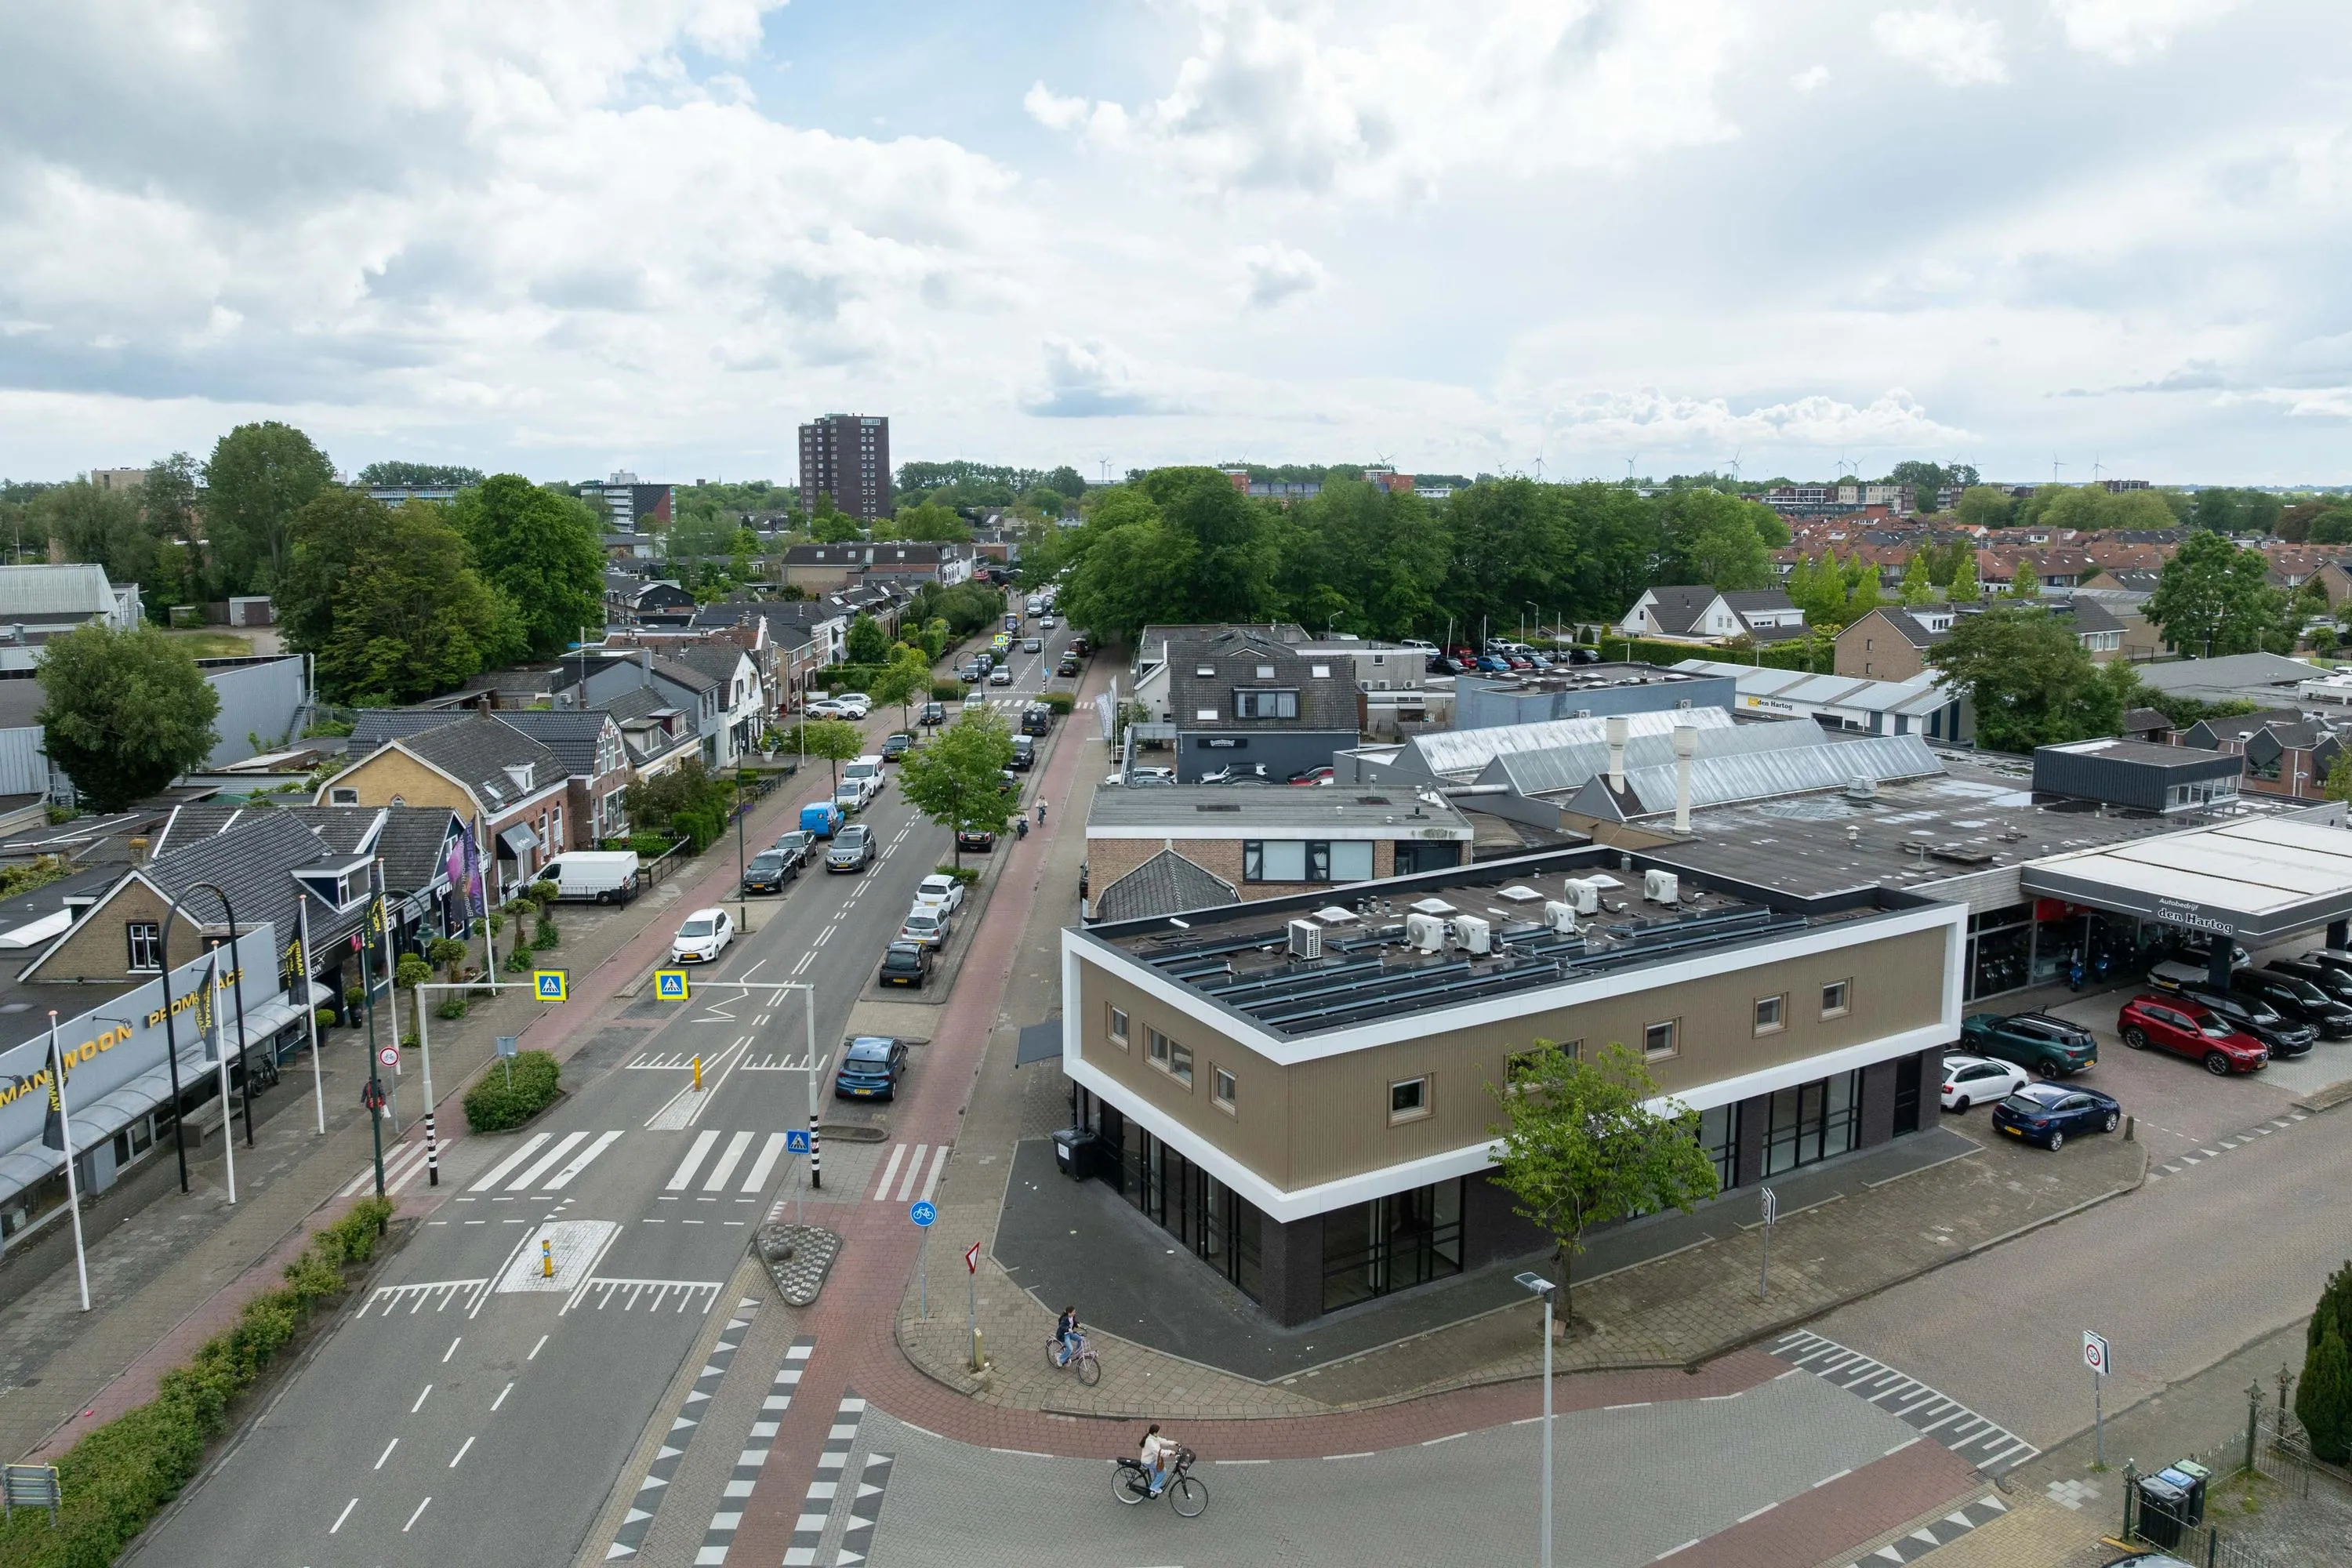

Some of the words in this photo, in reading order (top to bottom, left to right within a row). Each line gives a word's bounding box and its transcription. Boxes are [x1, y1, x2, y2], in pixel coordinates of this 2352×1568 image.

[1770, 701, 1793, 711] Hartog
[2158, 898, 2200, 911] Autobedrijf
[2158, 908, 2183, 921] den
[2186, 913, 2233, 935] Hartog
[147, 966, 245, 1028] PROMADE
[2089, 1349, 2098, 1361] 30
